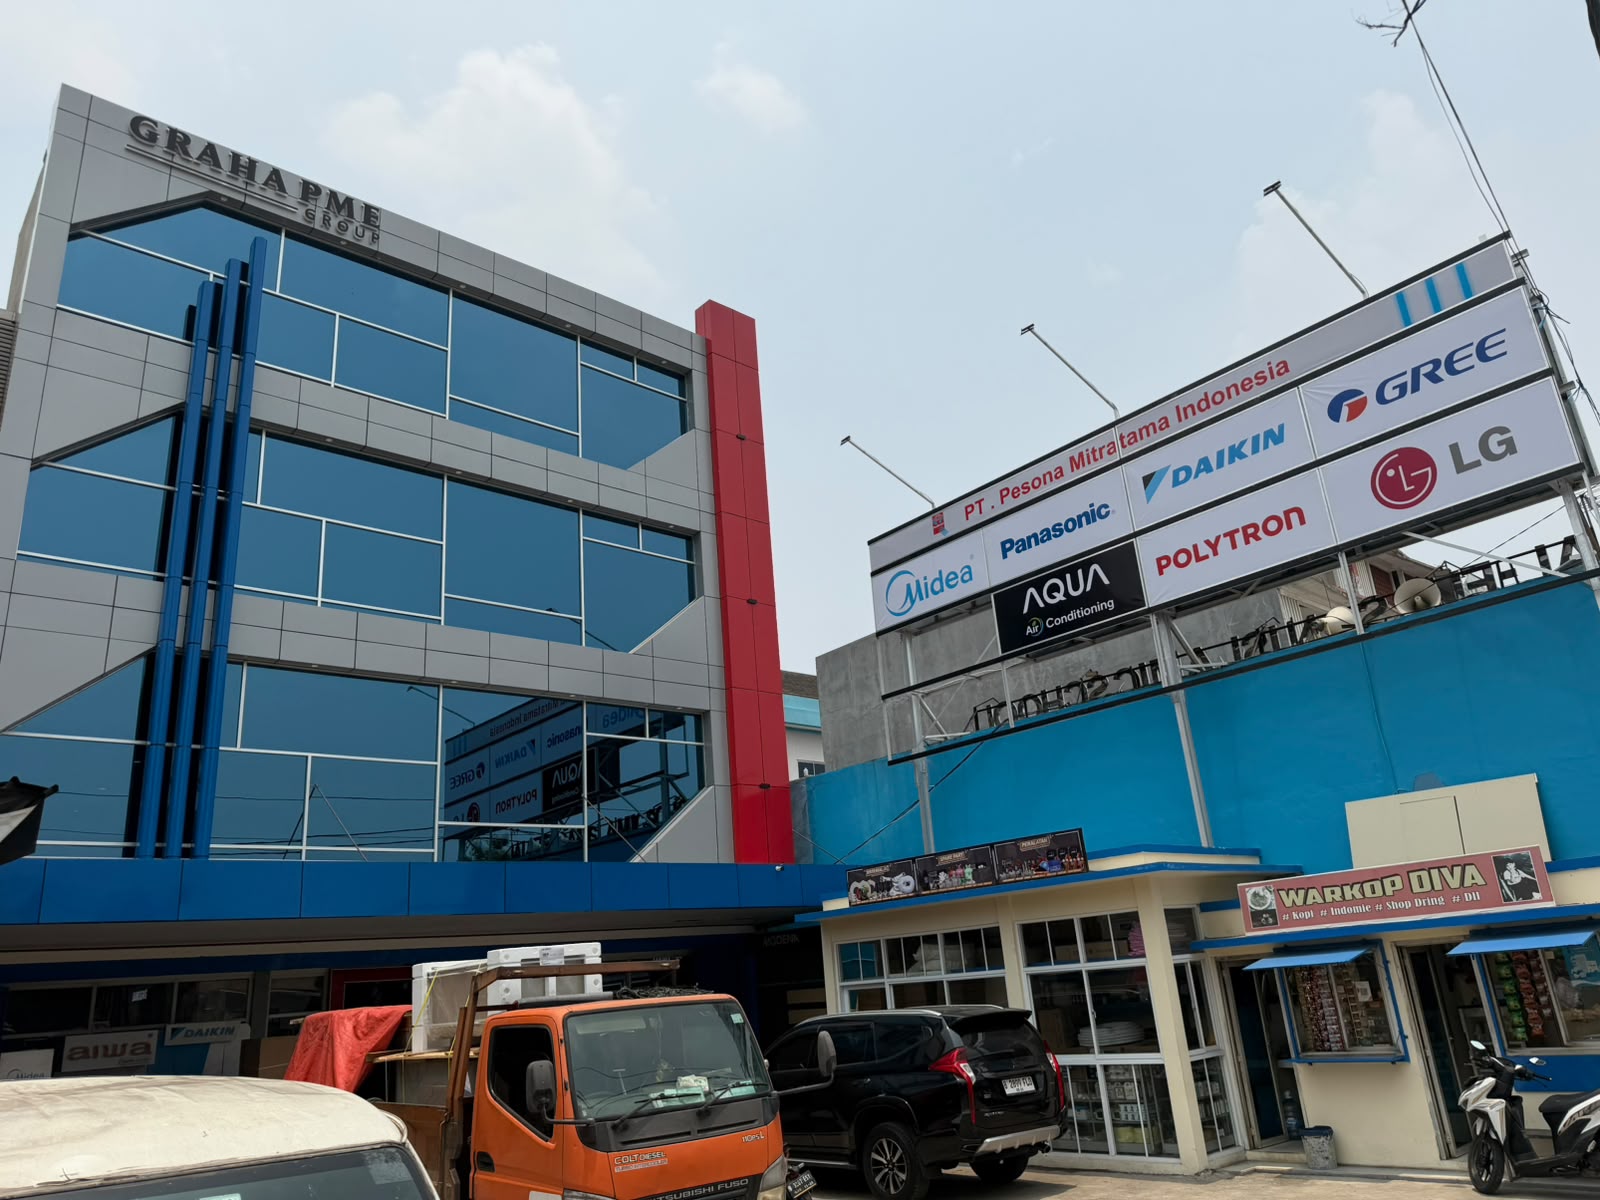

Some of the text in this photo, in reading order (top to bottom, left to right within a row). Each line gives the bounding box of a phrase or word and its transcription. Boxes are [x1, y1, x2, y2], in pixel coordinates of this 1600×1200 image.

[127, 114, 380, 229] GRAHA PME
[303, 207, 380, 245] GROUP
[1375, 328, 1508, 406] GREE
[963, 498, 986, 521] PT
[998, 466, 1065, 505] Pesona
[1068, 415, 1171, 473] Mitratama
[1175, 359, 1291, 423] Indonesia
[1171, 423, 1286, 489] DAIKIN
[1449, 425, 1518, 474] LG
[1000, 502, 1112, 560] Panasonic
[1155, 506, 1307, 577] POLYTRON
[885, 564, 975, 618] Midea
[1022, 562, 1111, 615] AQUA
[1025, 599, 1116, 637] Air Conditioning
[1278, 863, 1487, 908] WARKOP DIVA
[1292, 911, 1314, 921] Kopi
[1330, 903, 1372, 916] Indomie
[1386, 899, 1412, 912] Shop
[1415, 895, 1446, 908] Dring
[66, 1040, 152, 1062] aiwa
[184, 1025, 236, 1039] DAIKIN
[614, 1153, 639, 1165] COLT
[639, 1151, 666, 1161] DIESEL
[718, 1178, 749, 1191] FUSO
